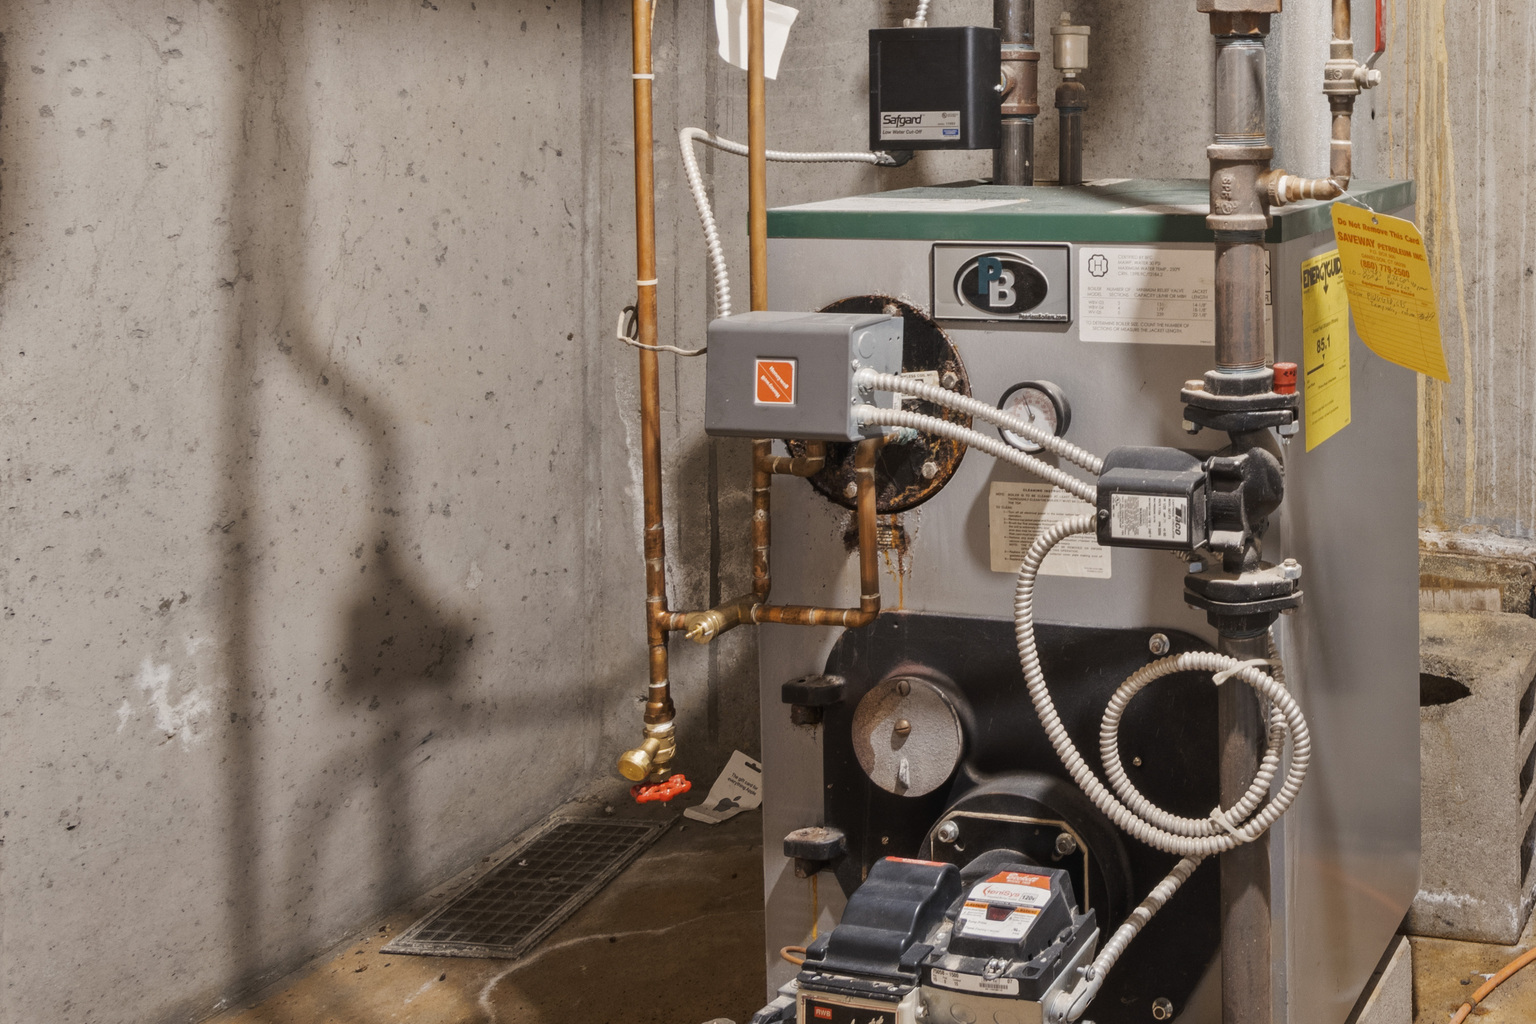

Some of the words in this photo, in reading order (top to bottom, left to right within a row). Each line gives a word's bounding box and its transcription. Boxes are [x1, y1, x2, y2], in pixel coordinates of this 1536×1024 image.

[882, 114, 922, 128] Safgard
[1337, 217, 1347, 226] Do
[1348, 220, 1361, 230] Not
[1362, 223, 1388, 237] Remove
[1389, 230, 1404, 241] This
[1404, 234, 1420, 246] Card
[1337, 231, 1375, 248] SAVEWAY
[1377, 242, 1412, 258] PETROLEUM
[1412, 251, 1426, 262] INC.
[1303, 256, 1344, 289] ENERGYGUID
[1316, 334, 1331, 354] 85.1
[728, 777, 746, 791] everything
[746, 787, 757, 796] Apple
[738, 776, 746, 784] gift
[744, 780, 754, 788] card
